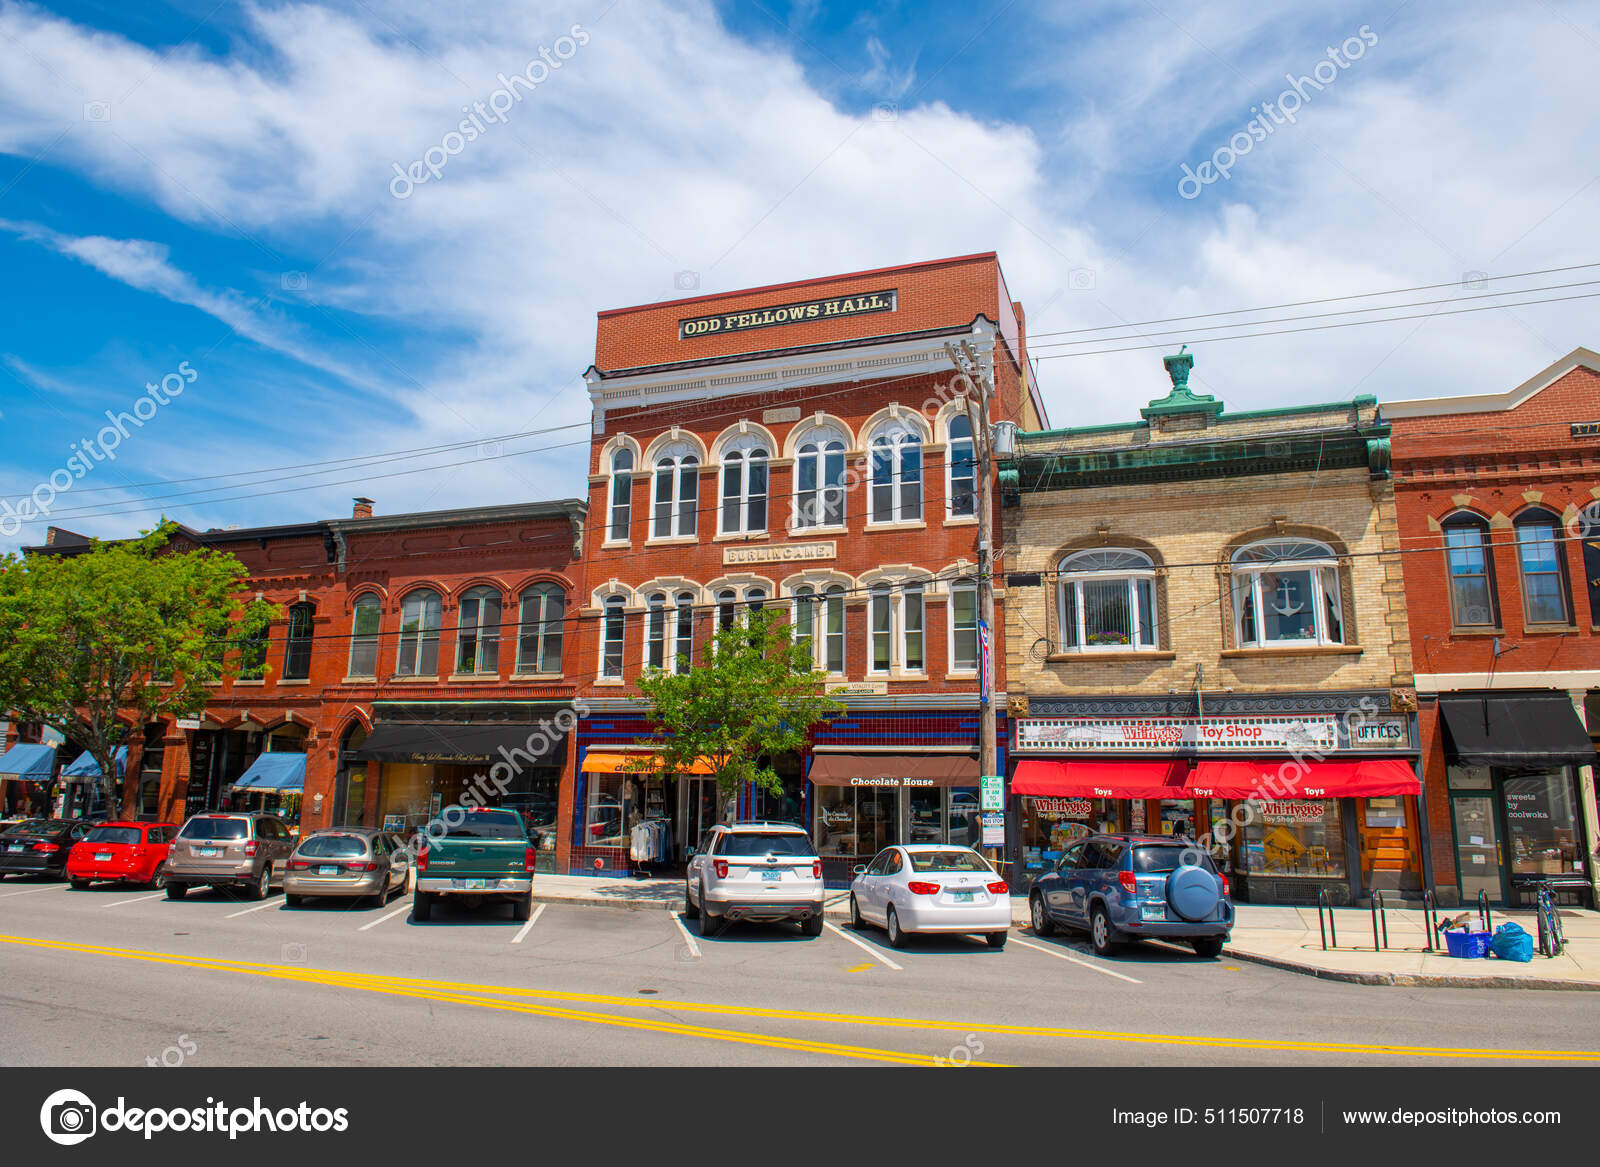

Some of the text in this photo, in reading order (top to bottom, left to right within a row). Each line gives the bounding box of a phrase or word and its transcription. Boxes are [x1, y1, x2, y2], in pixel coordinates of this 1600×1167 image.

[684, 295, 889, 335] ODD FELLOWS HALL.
[1121, 725, 1262, 742] Whirlygigs Toy Shop
[1357, 724, 1401, 739] OFFICES
[850, 777, 934, 786] Chocolate House
[1094, 788, 1112, 797] Toys
[1194, 788, 1213, 797] Toys
[1304, 787, 1324, 797] Toys
[1507, 793, 1536, 801] sweets
[1034, 798, 1092, 817] Whirlygigs
[1259, 801, 1325, 818] Whirlygigs
[1508, 801, 1518, 810] by
[1038, 811, 1048, 820] Toy
[1264, 816, 1275, 824] Toy
[1279, 815, 1296, 824] Shop
